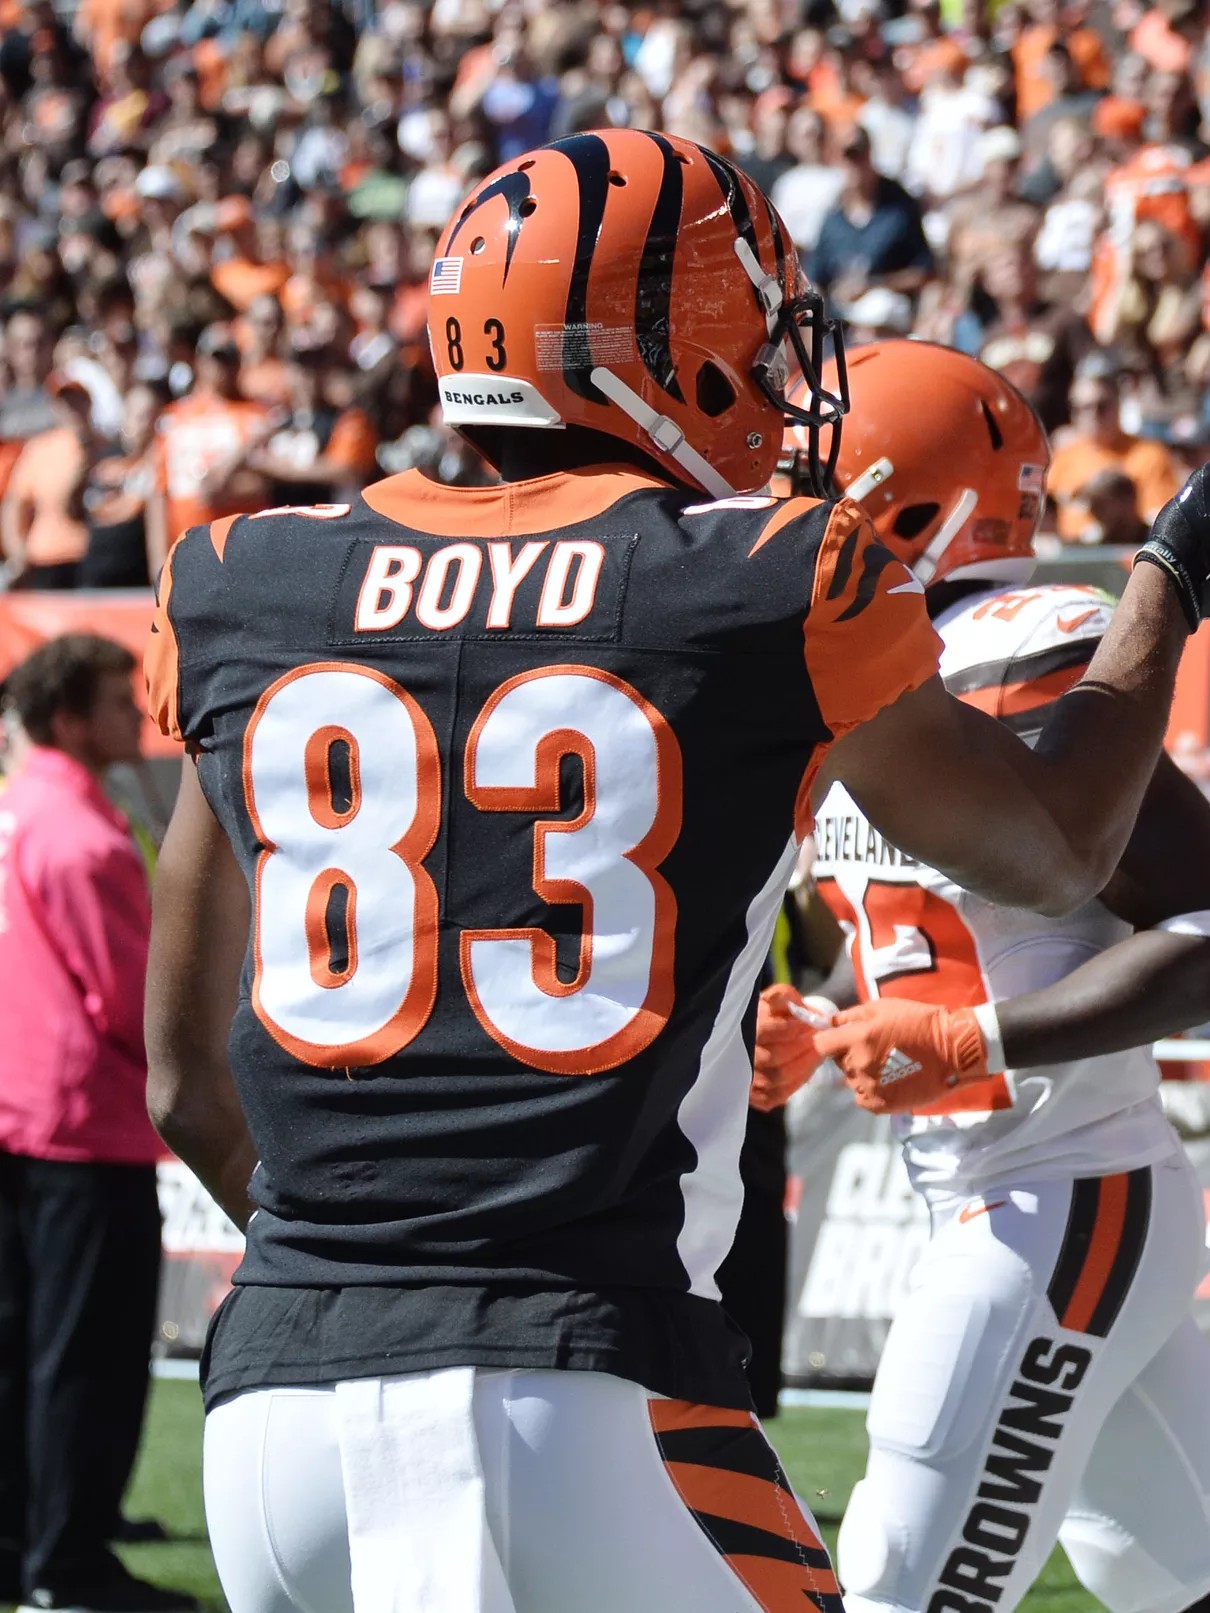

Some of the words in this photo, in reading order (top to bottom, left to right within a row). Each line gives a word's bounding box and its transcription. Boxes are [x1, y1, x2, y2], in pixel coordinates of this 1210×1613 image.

[563, 321, 604, 331] WARNING
[444, 390, 525, 406] BENGALS
[354, 539, 605, 633] BOYD
[242, 661, 684, 1076] 83
[879, 1060, 923, 1088] adidas
